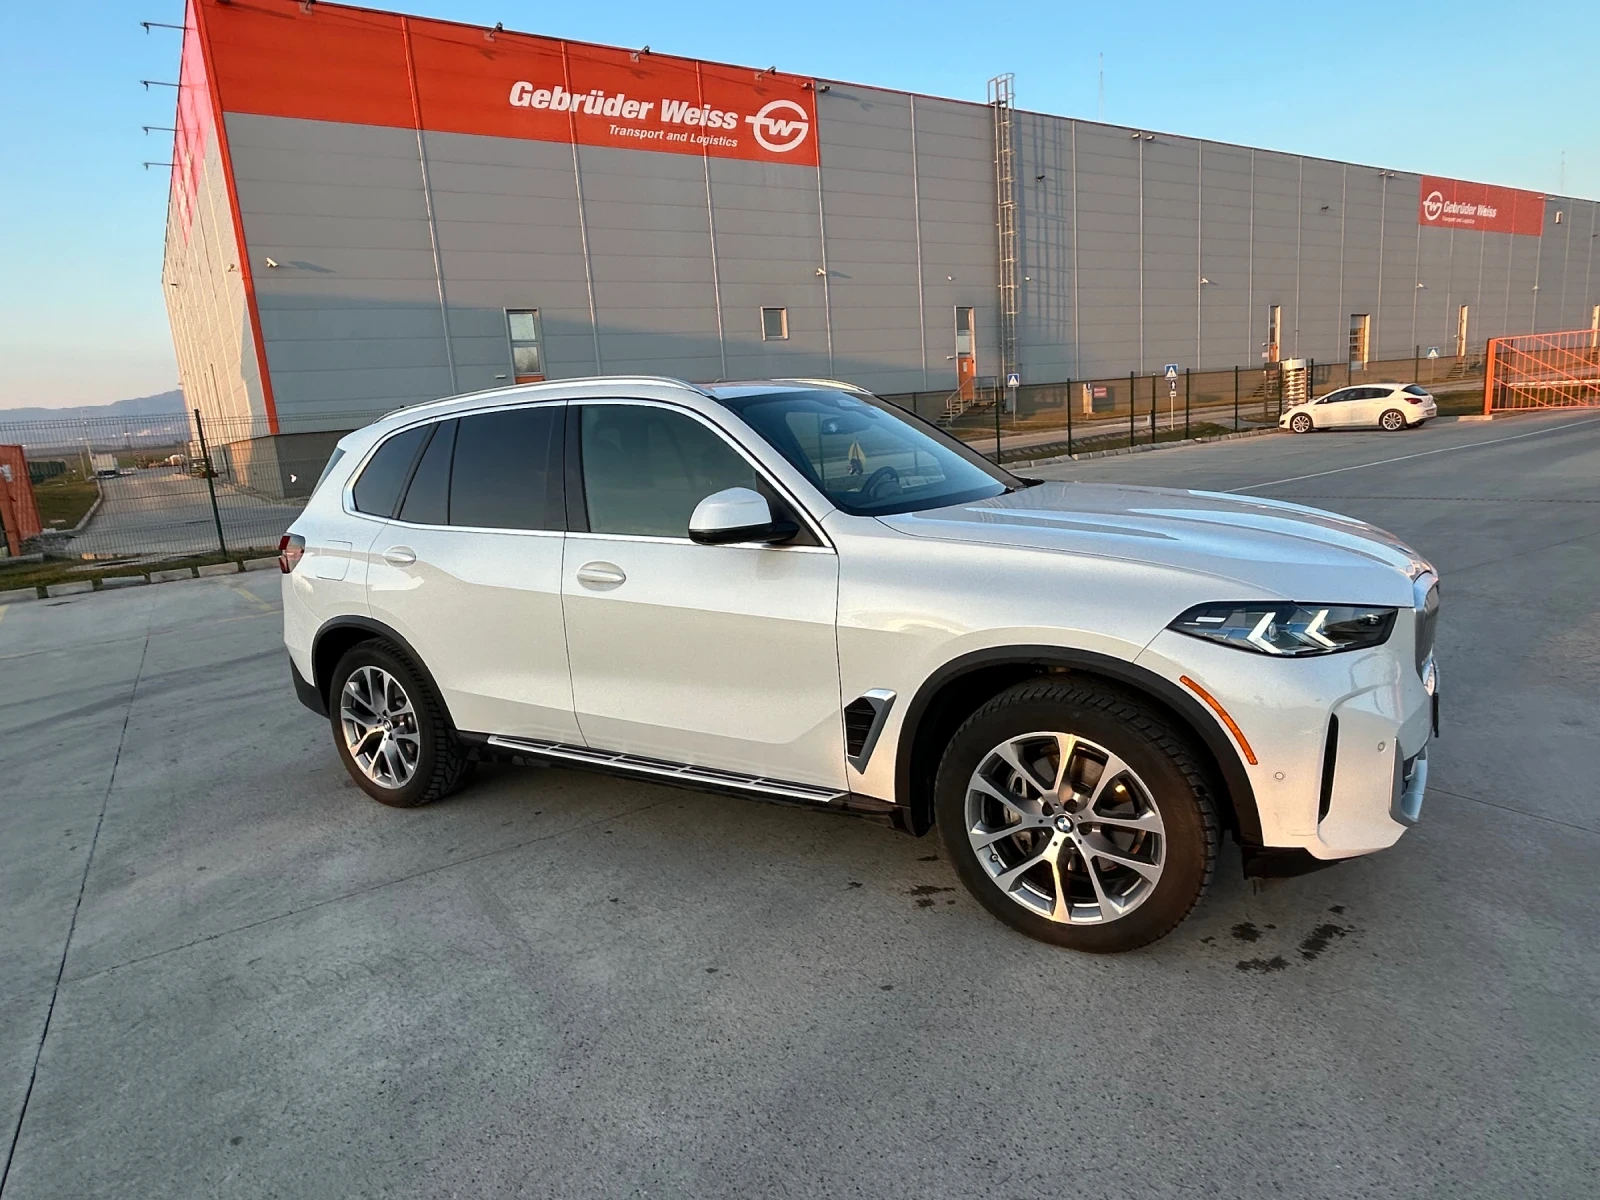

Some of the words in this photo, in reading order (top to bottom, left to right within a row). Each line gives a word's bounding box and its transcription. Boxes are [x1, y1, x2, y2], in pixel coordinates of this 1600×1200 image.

[508, 81, 654, 120] Gebrüder
[660, 99, 739, 130] Weiss
[609, 124, 664, 141] Transport
[666, 131, 688, 142] and
[690, 133, 738, 148] Logistics
[1444, 201, 1477, 215] Gebrüder
[1477, 204, 1497, 217] Weiss
